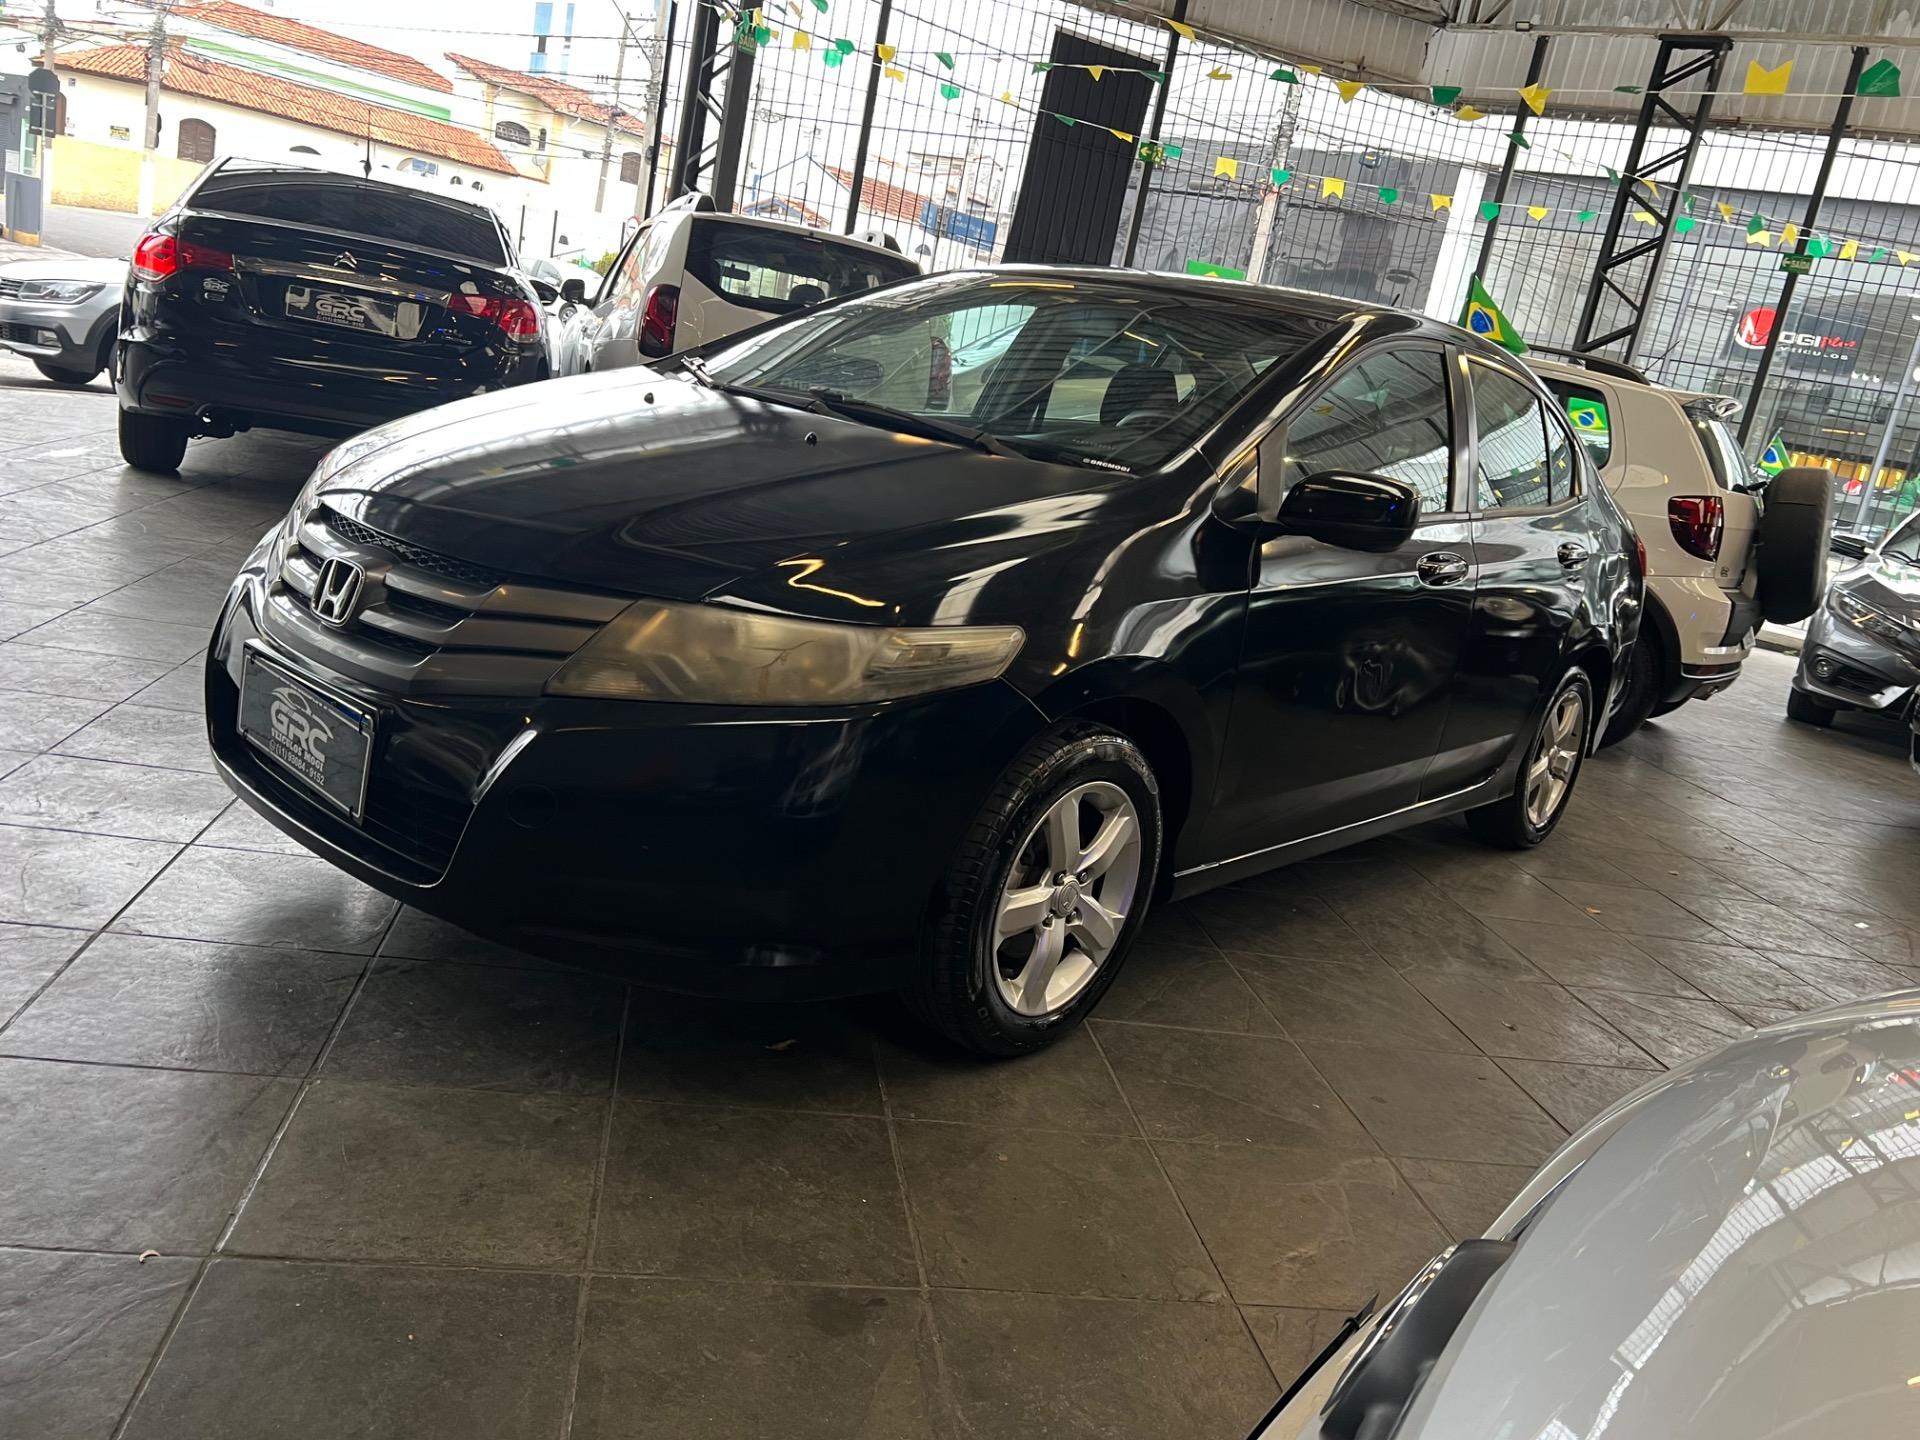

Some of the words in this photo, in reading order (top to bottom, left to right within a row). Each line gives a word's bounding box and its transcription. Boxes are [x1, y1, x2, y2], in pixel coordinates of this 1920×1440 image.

[315, 299, 366, 320] GRC
[271, 700, 328, 763] GRC
[303, 751, 324, 772] MOGI
